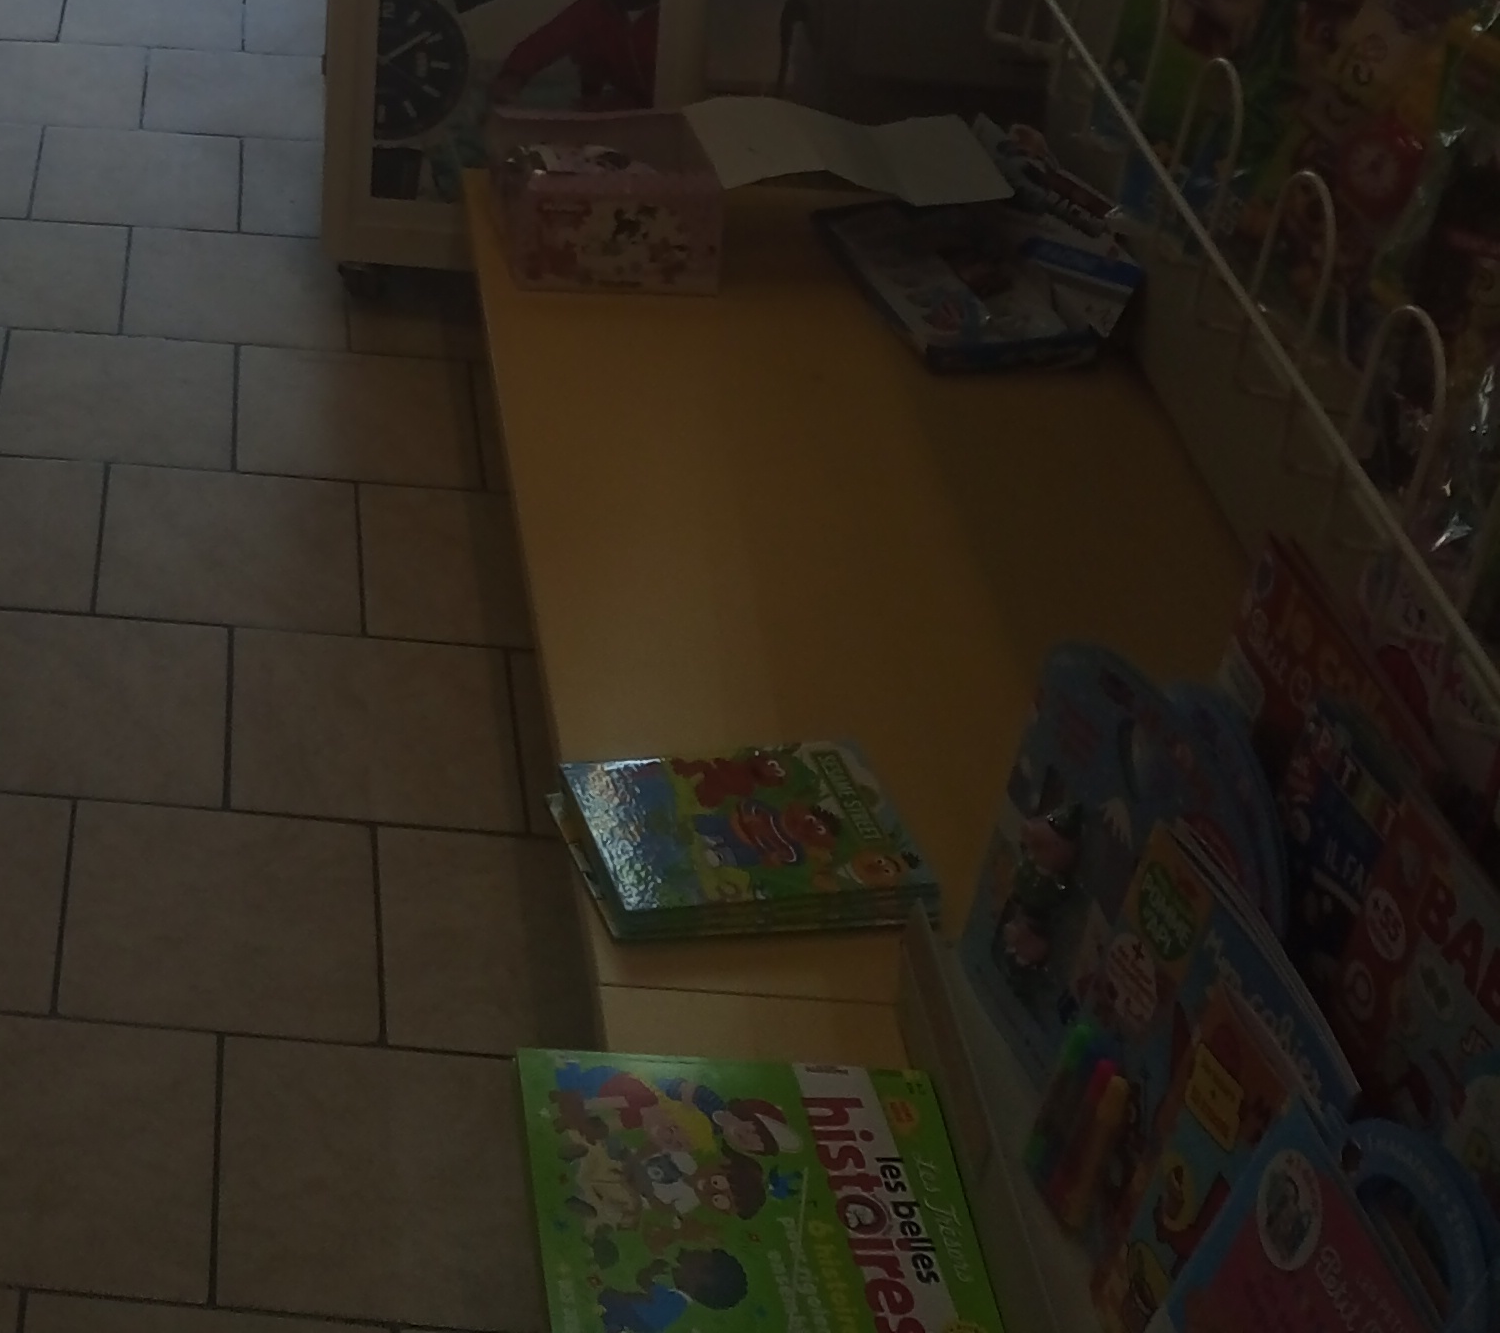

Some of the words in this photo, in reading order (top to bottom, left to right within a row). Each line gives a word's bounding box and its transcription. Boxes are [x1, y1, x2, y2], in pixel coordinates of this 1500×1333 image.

[801, 1097, 927, 1333] histoires
[874, 1156, 909, 1195] les
[890, 1201, 941, 1285] belles
